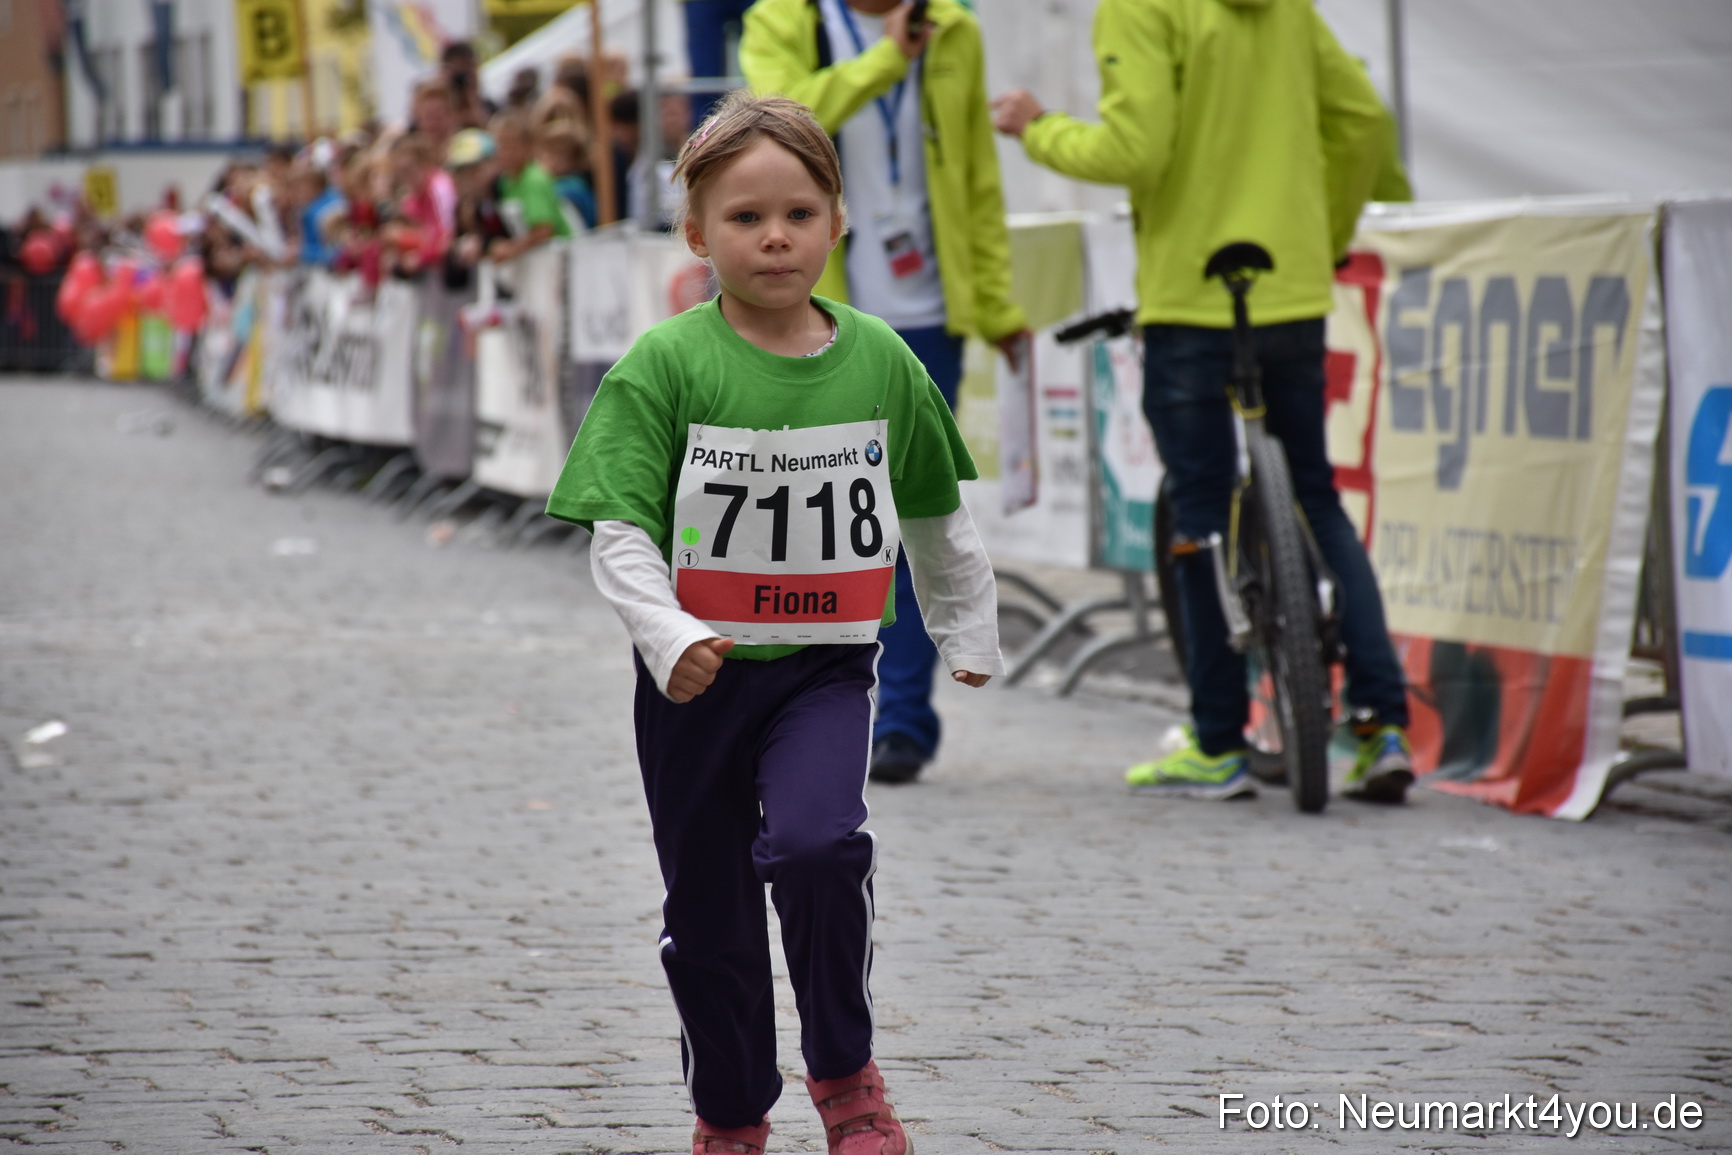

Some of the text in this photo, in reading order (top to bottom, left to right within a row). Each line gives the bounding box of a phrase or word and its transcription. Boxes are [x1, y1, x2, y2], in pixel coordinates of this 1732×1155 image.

[690, 447, 858, 473] PARTL Neumarkt
[704, 477, 883, 562] 7118
[885, 550, 892, 562] K
[754, 585, 837, 615] Fiona
